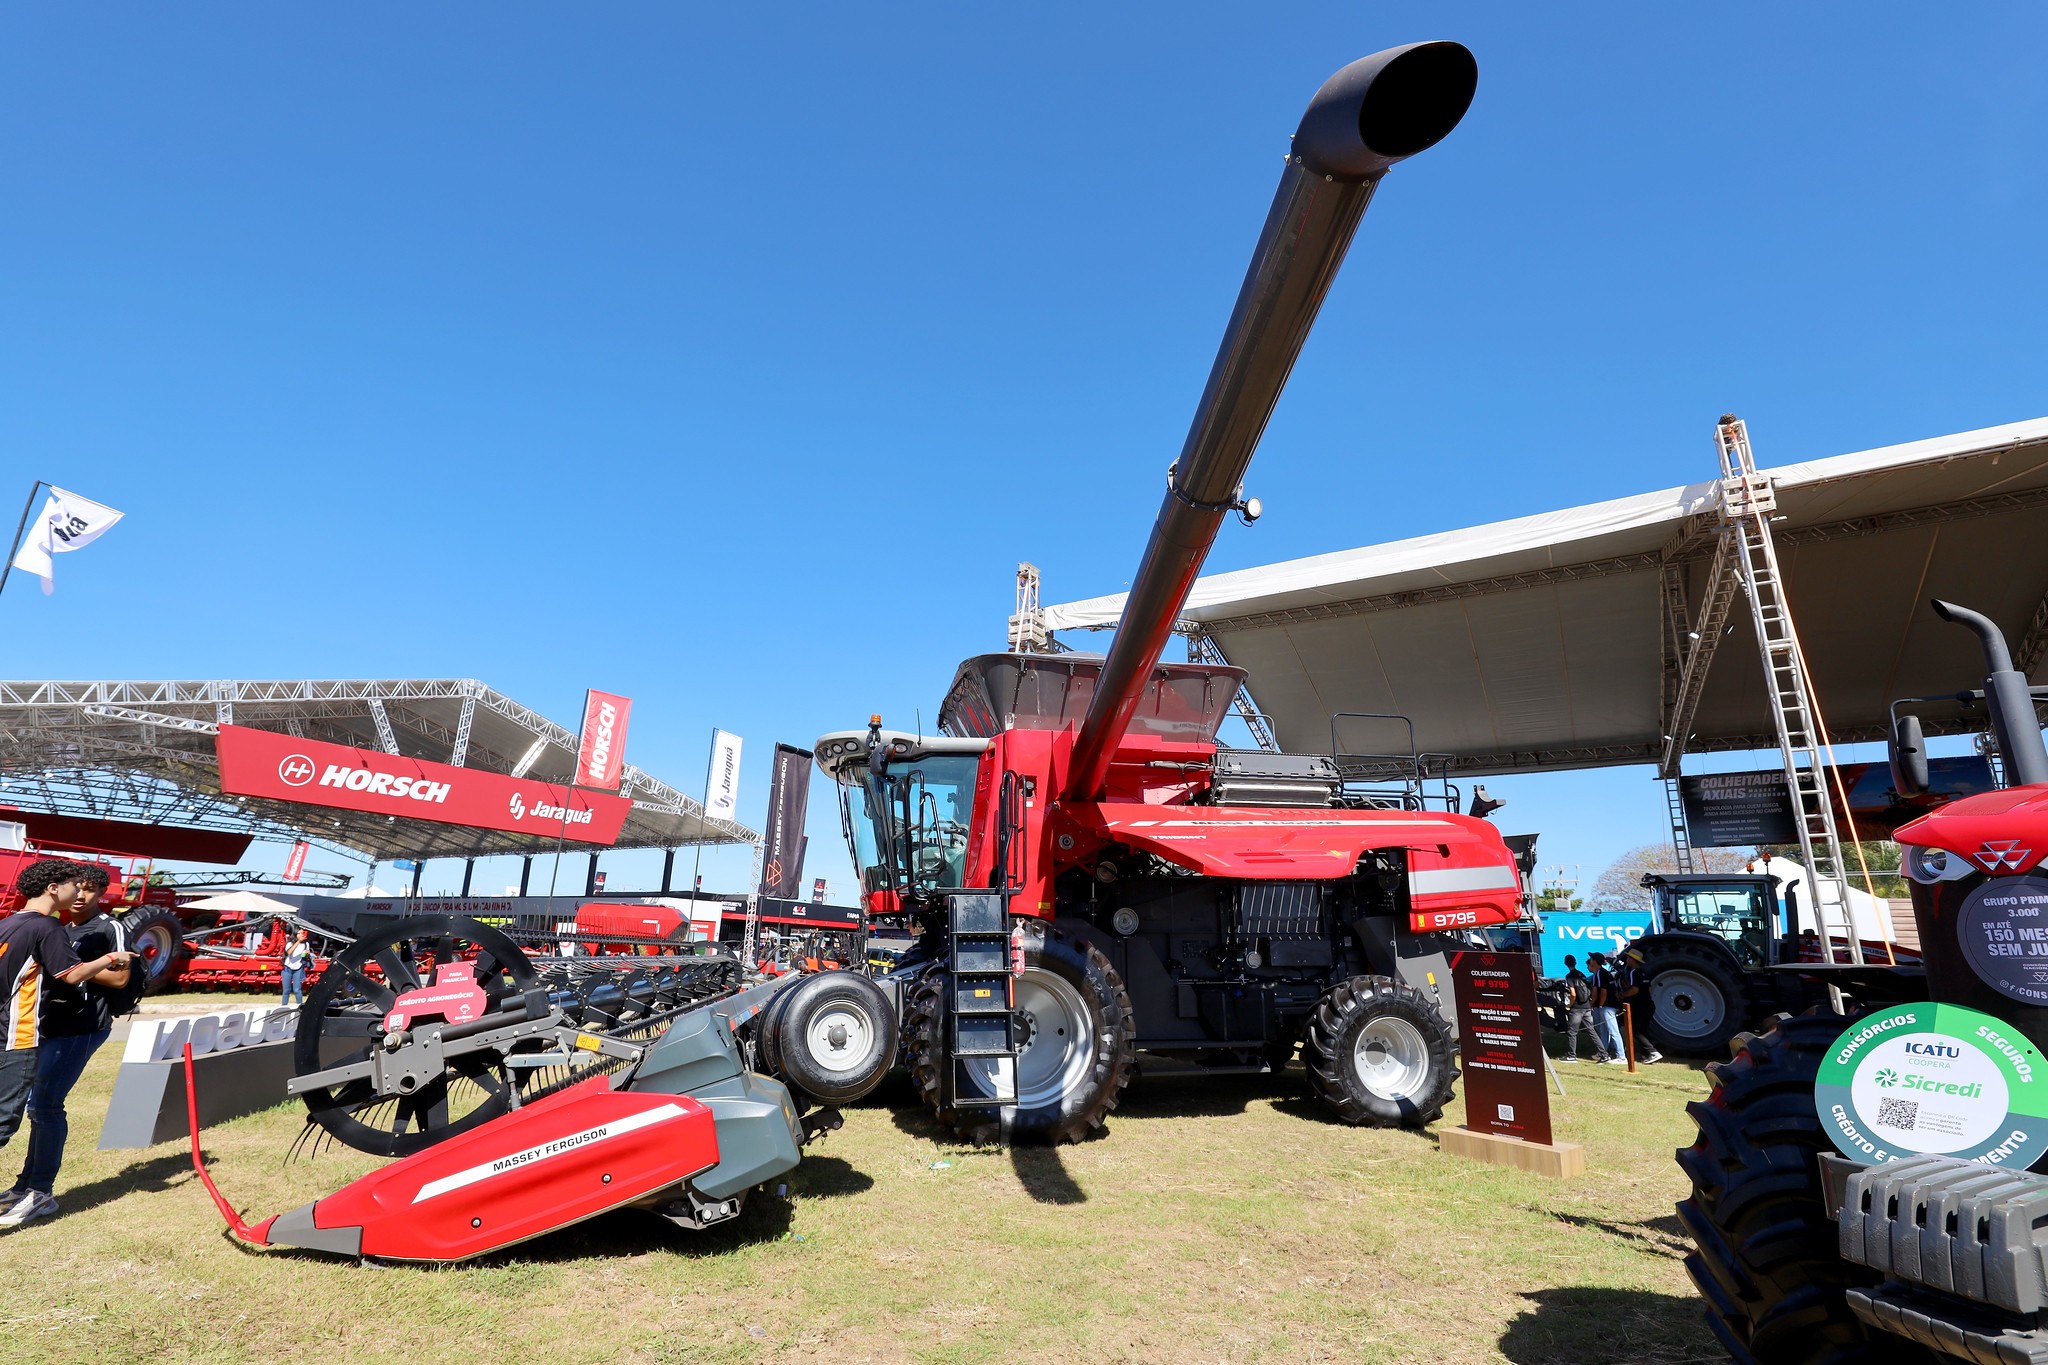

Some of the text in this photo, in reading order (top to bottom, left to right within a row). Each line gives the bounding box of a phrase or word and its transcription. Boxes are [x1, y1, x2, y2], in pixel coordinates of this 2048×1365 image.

[589, 701, 615, 780] HORSCH
[722, 746, 734, 794] Jaraguá
[319, 764, 451, 803] HORSCH
[1700, 774, 1811, 788] COLHEITADEIS
[1702, 787, 1747, 801] AXIAIS
[530, 800, 594, 824] Jaraguá
[775, 757, 788, 856] MASSEY FERGUSON
[1984, 897, 2018, 906] GRUPO
[1434, 911, 1477, 927] 9795
[2008, 908, 2039, 917] 3.000
[1997, 920, 2012, 928] ATÉ
[1558, 926, 1644, 940] IVECO
[1985, 930, 2014, 941] 150
[1988, 944, 2023, 956] SEM
[1471, 970, 1510, 978] COLHEITADEIRA
[1488, 980, 1509, 989] 9795
[399, 992, 474, 1006] CRÉDITO AGRONEGÓCIO
[1837, 1014, 1916, 1065] CONSÓRCIOS
[1905, 1042, 1960, 1058] ICATU
[1975, 1025, 2033, 1083] SEGUROS
[1908, 1058, 1951, 1069] COOPERA
[1902, 1074, 1982, 1098] Sicredi
[1831, 1104, 1874, 1154] CRÉDITO
[1875, 1152, 1887, 1161] E
[493, 1128, 607, 1171] MASSEY FERGUSON
